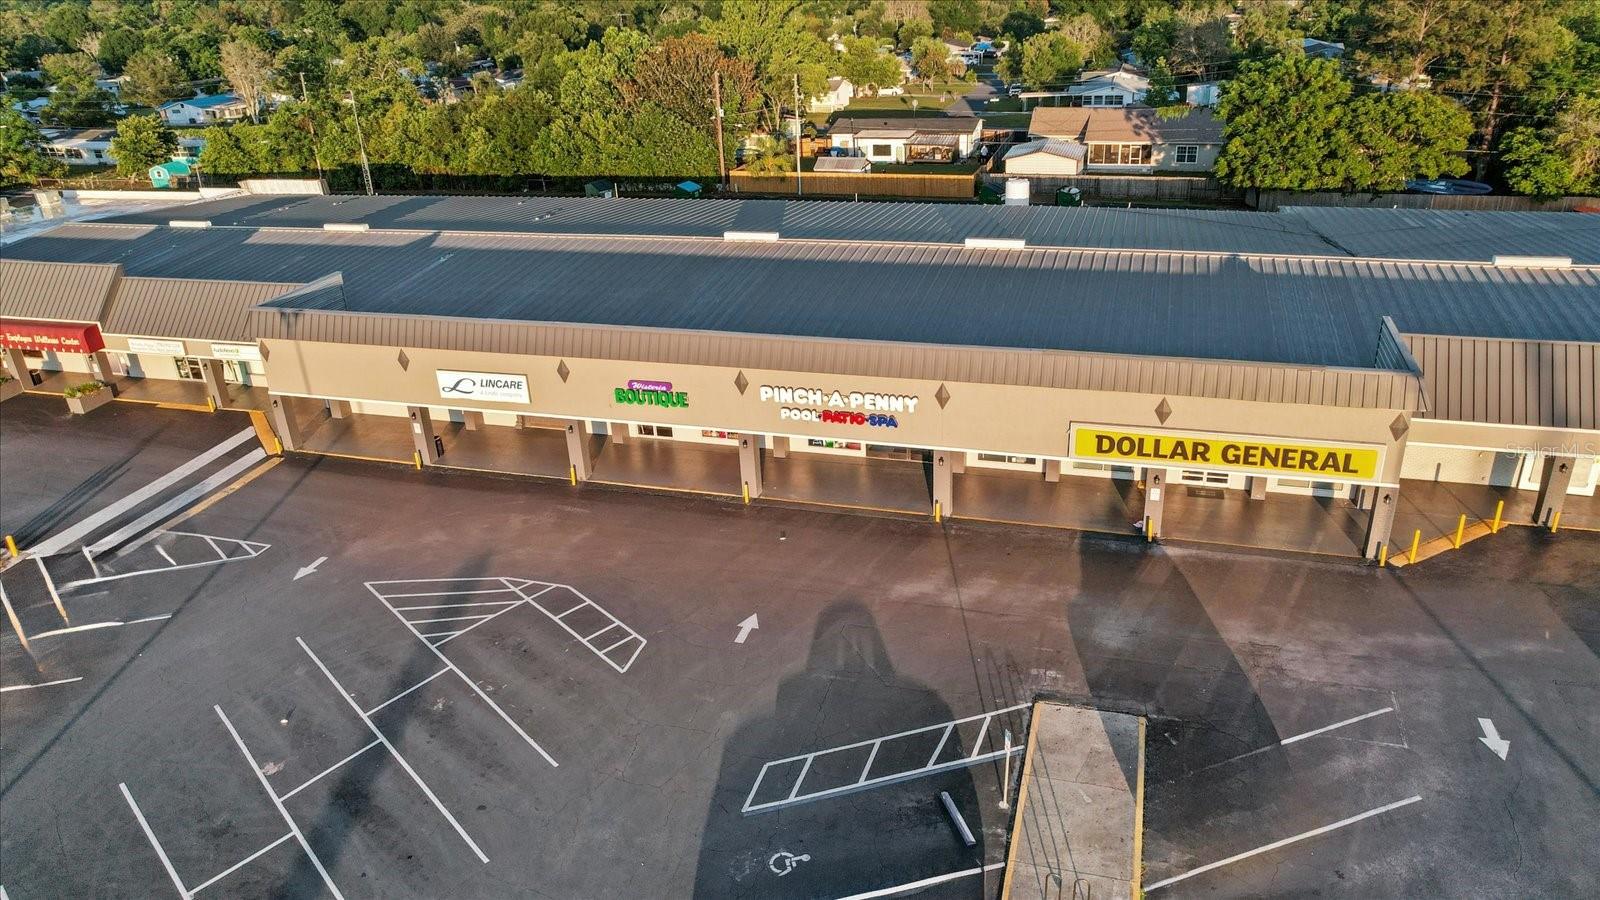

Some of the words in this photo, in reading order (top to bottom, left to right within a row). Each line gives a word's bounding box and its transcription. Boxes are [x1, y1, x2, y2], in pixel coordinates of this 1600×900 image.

[480, 378, 523, 390] LINCARE
[614, 387, 689, 408] BOUTIQUE
[1095, 434, 1210, 462] DOLLAR
[1221, 444, 1358, 473] GENERAL
